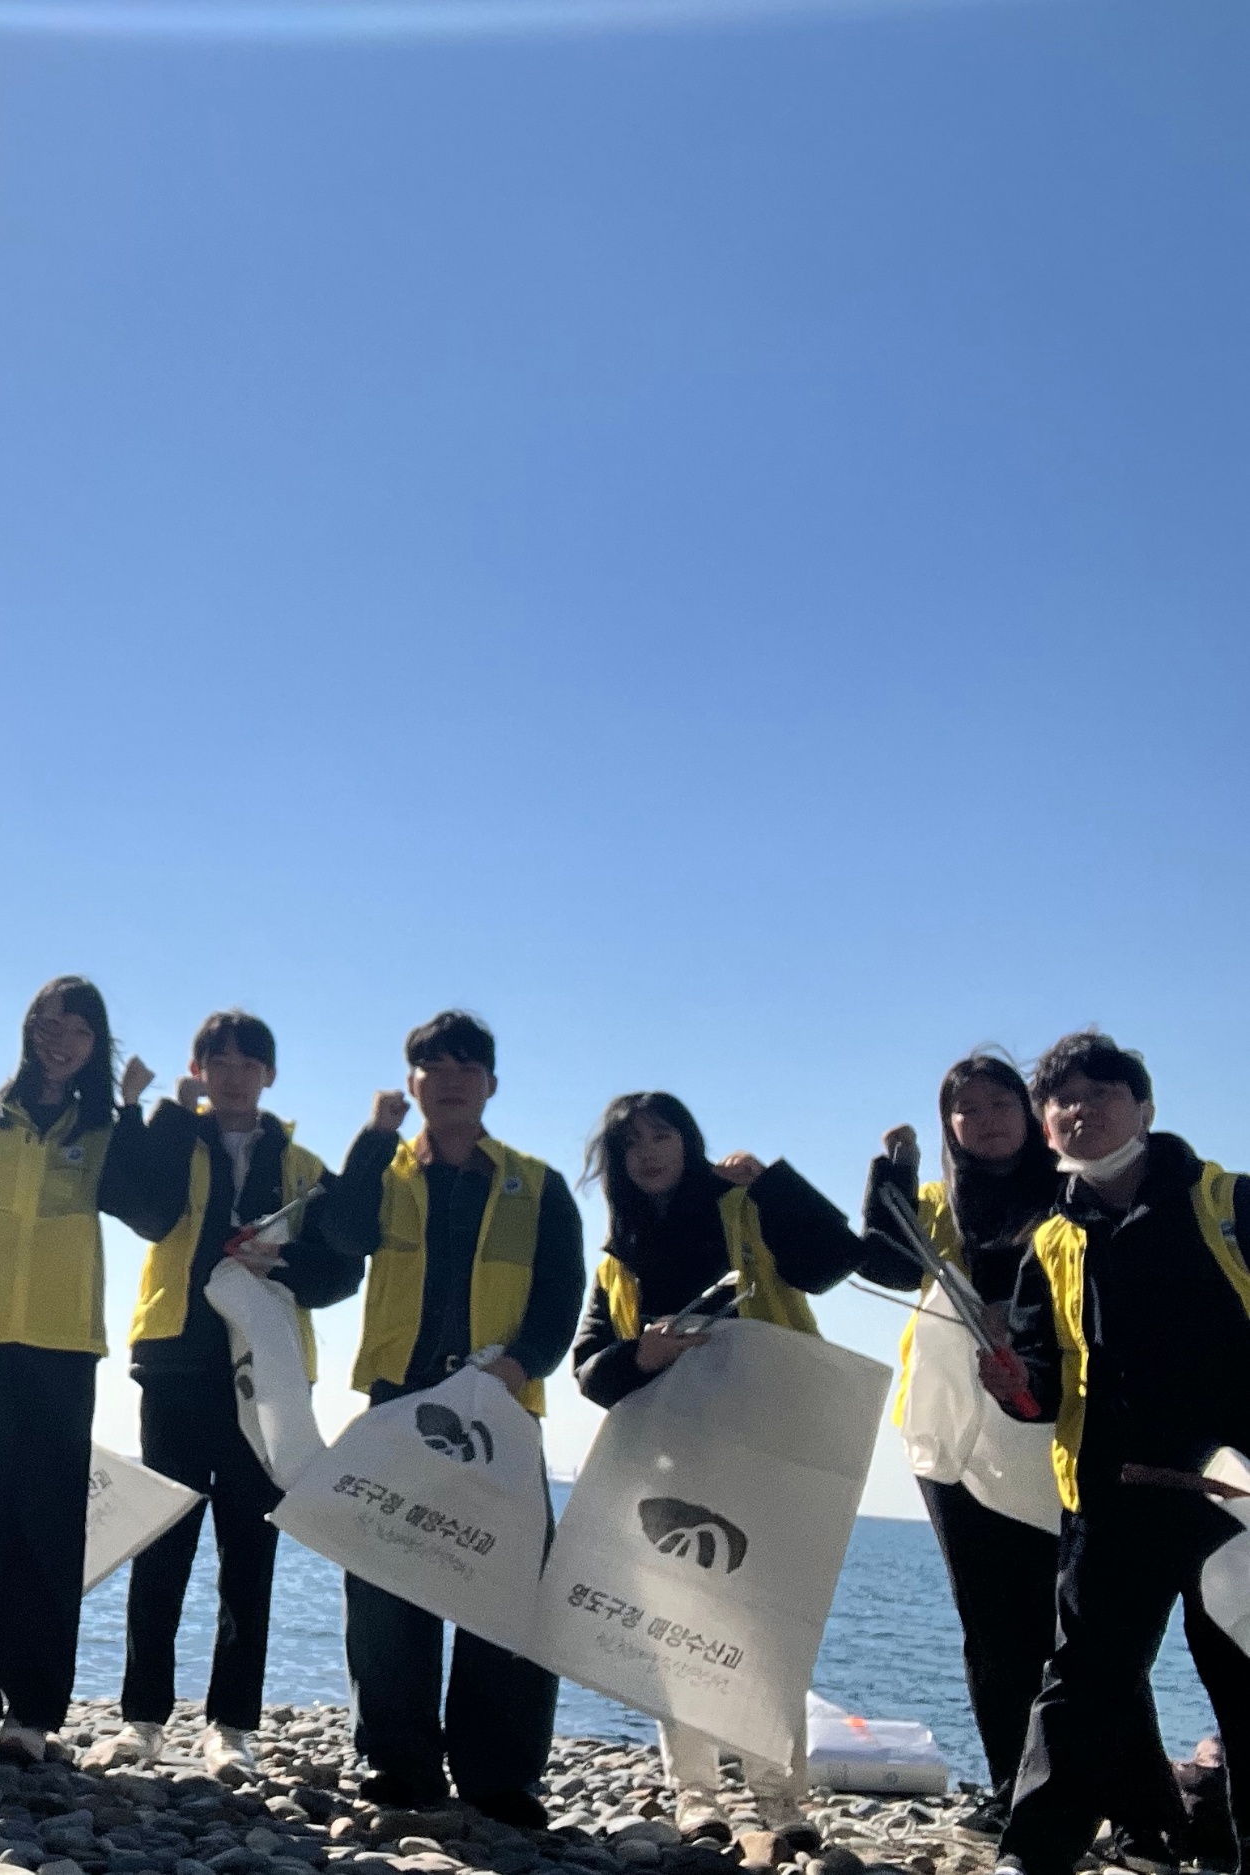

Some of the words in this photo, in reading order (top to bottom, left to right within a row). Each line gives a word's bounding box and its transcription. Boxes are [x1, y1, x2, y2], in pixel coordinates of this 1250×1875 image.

[333, 1474, 405, 1515] 영도구청
[405, 1503, 497, 1556] 해양수산과
[567, 1583, 644, 1628] 영도구청
[647, 1617, 744, 1670] 해양수산과
